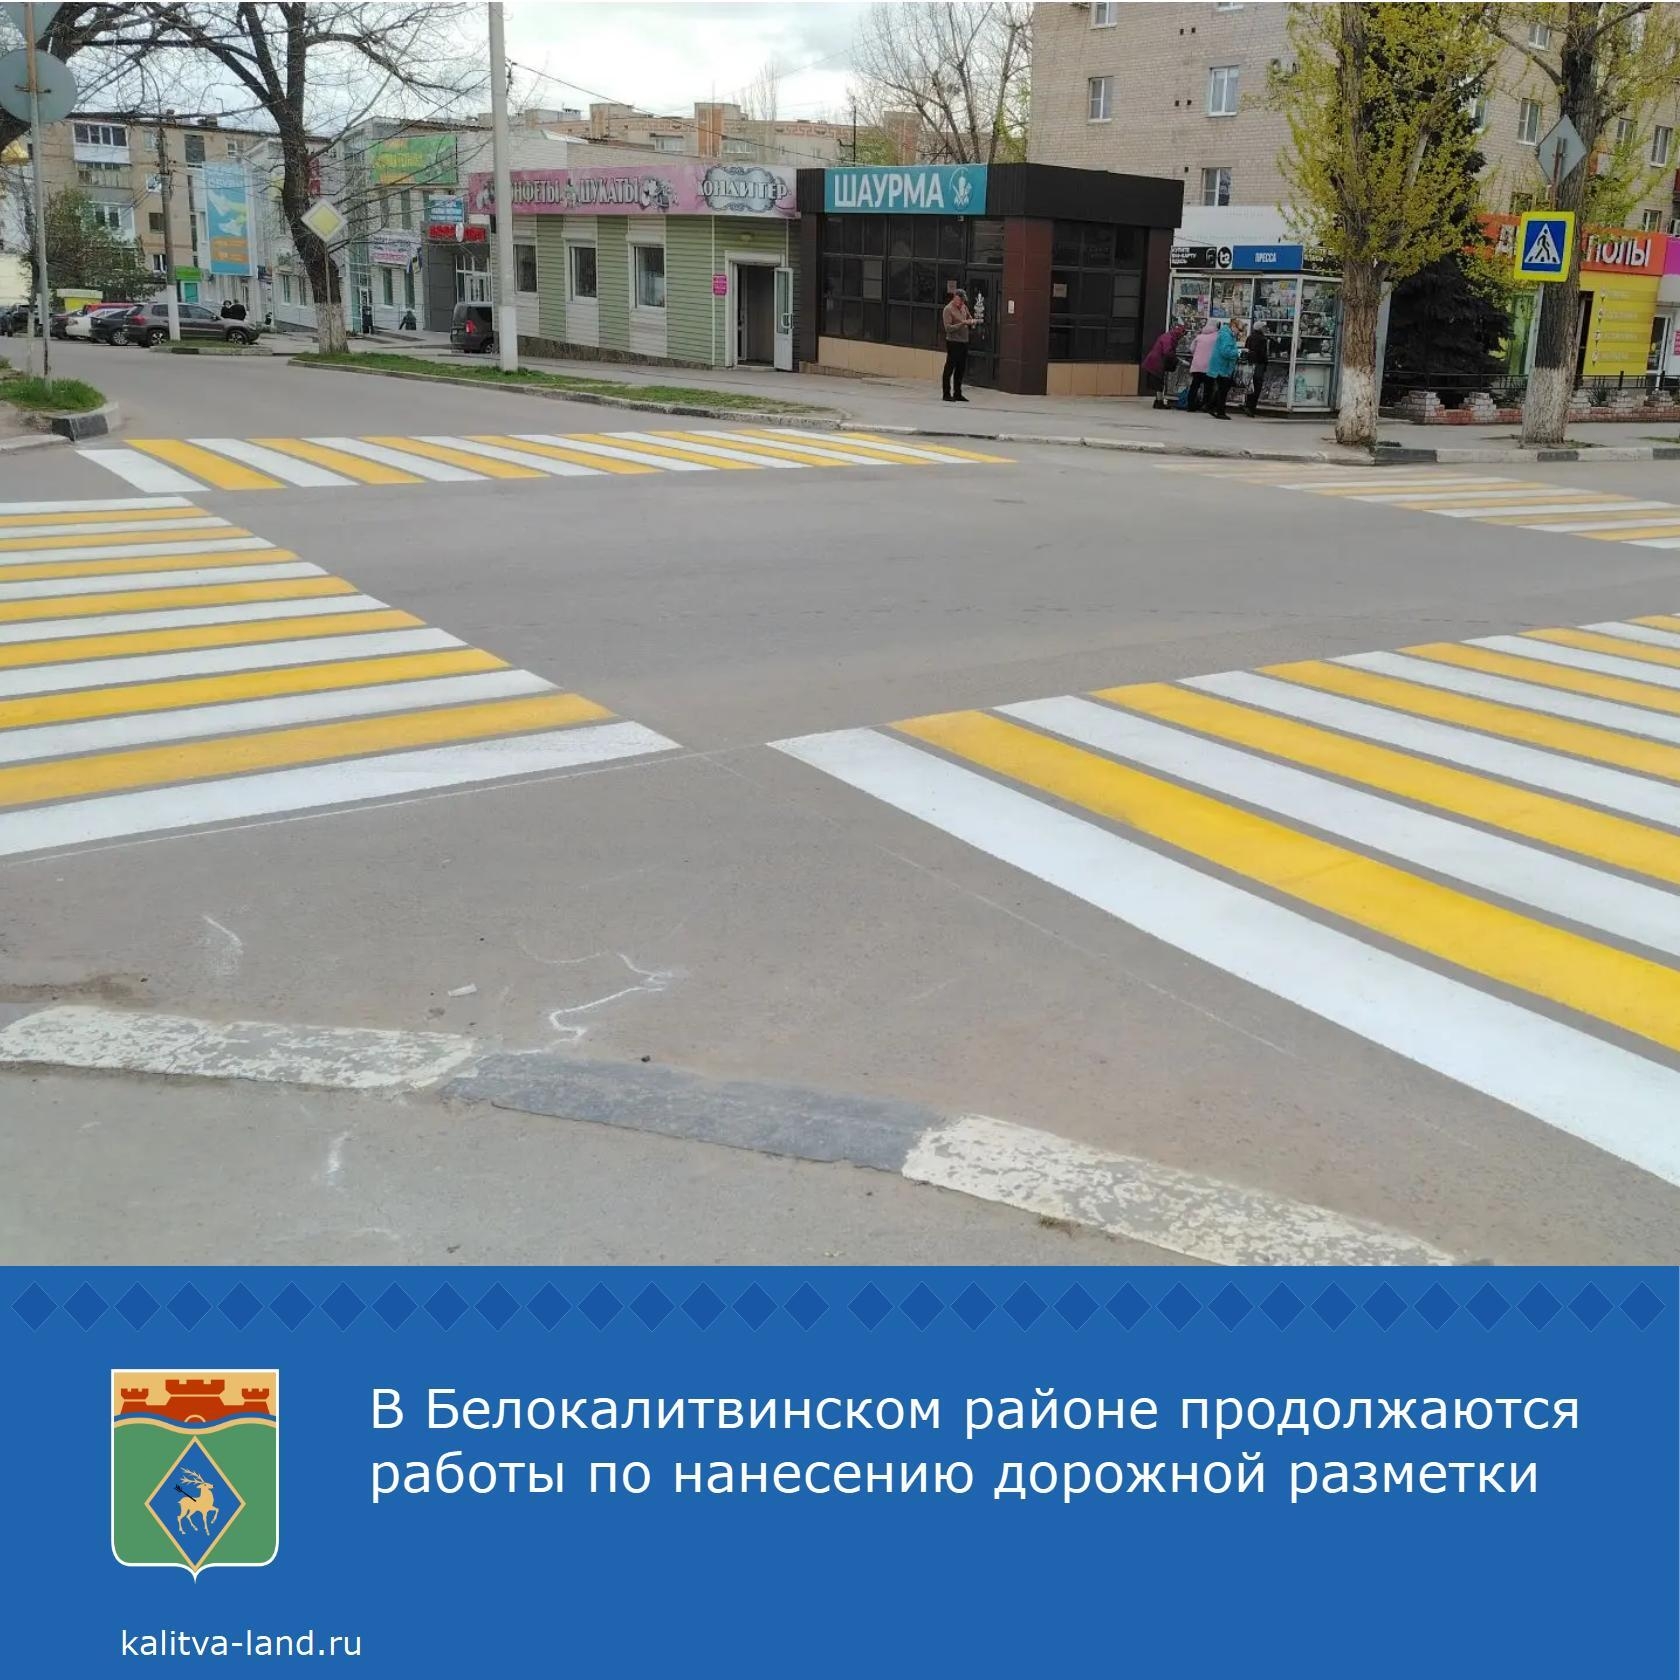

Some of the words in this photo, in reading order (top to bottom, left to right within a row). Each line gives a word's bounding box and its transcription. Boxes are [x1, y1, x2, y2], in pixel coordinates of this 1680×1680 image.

[487, 178, 560, 204] НФЕТЫ
[834, 173, 945, 208] ШАУРМА
[1254, 252, 1276, 262] ПРЕССА
[1586, 234, 1652, 267] ПОЛЫ
